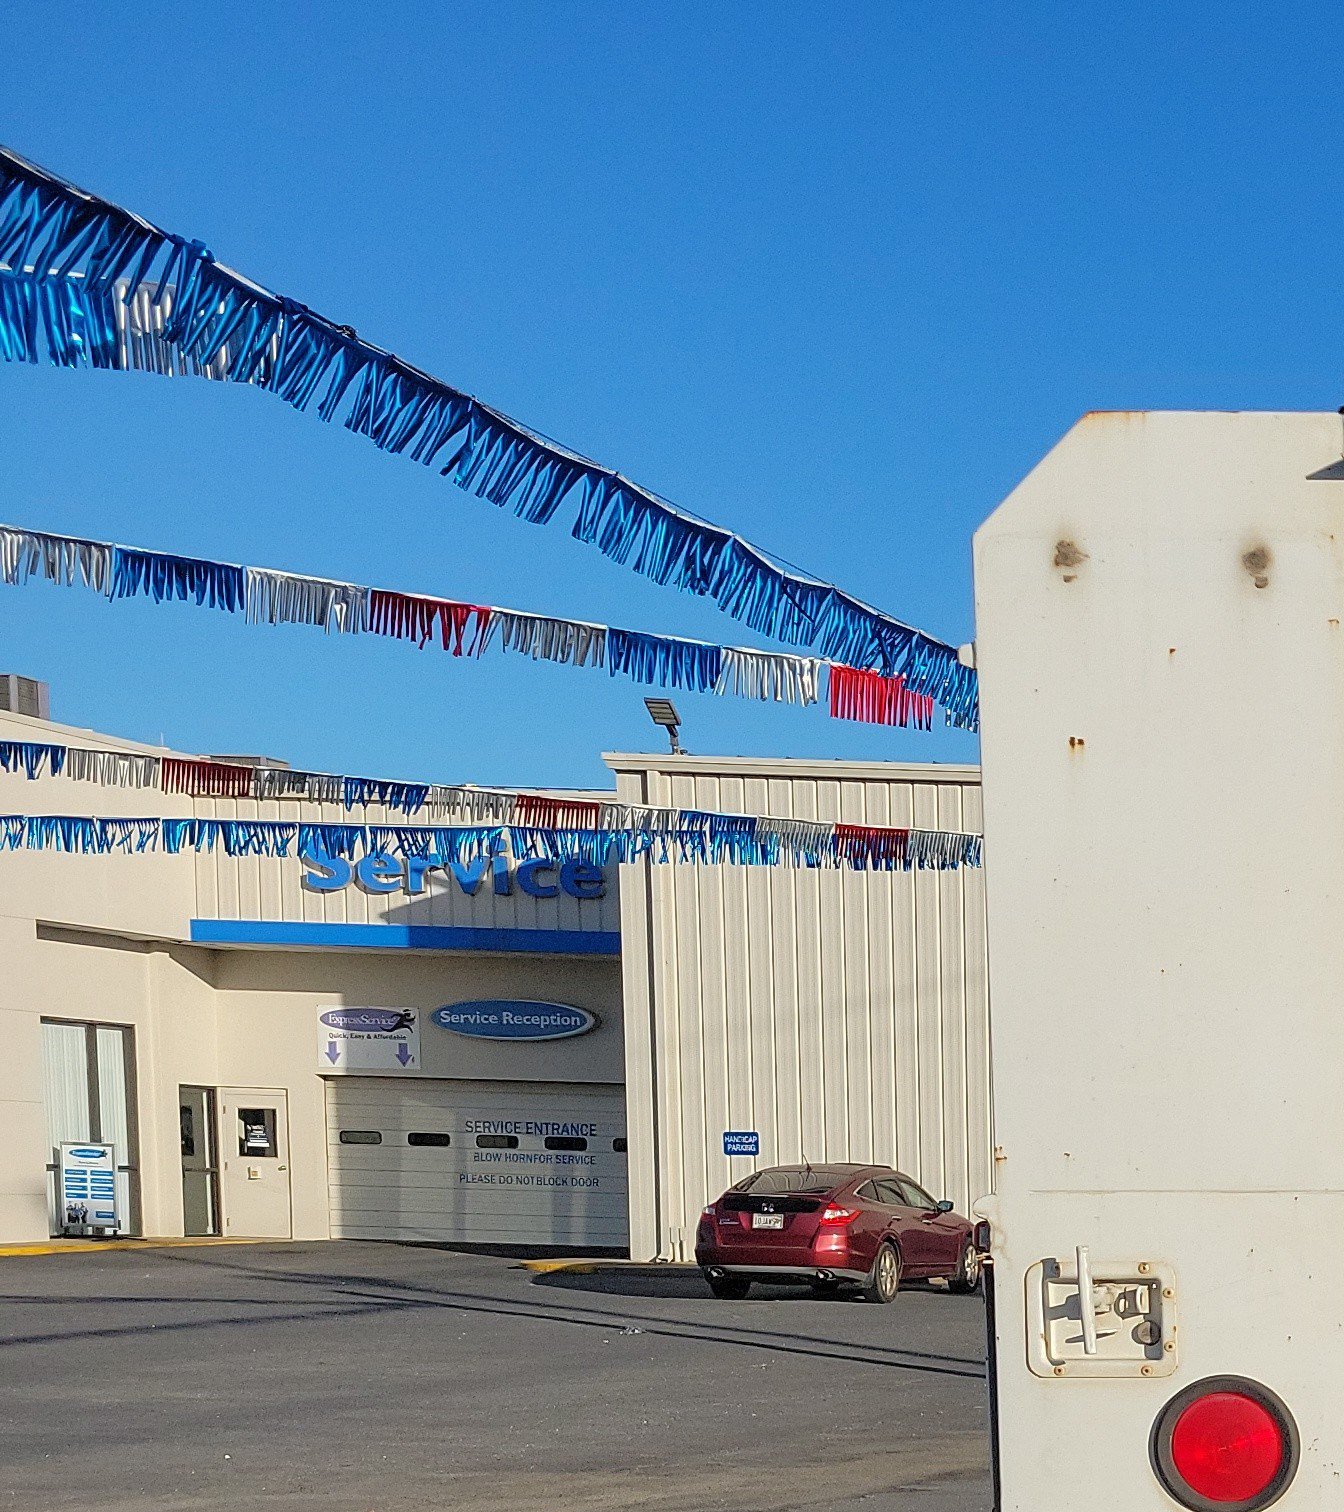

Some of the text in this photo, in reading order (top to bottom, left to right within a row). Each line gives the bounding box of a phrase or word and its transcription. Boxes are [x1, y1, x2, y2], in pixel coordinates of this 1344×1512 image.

[303, 835, 603, 897] Service
[440, 1010, 581, 1028] Service Reception
[465, 1120, 597, 1136] SERVICE ENTRANCE
[724, 1135, 758, 1144] HANDICAP
[727, 1143, 757, 1152] PARKING
[555, 1154, 597, 1165] SERVICE
[460, 1173, 496, 1185] PLEASE
[499, 1175, 513, 1185] DO
[571, 1177, 600, 1187] DOOR
